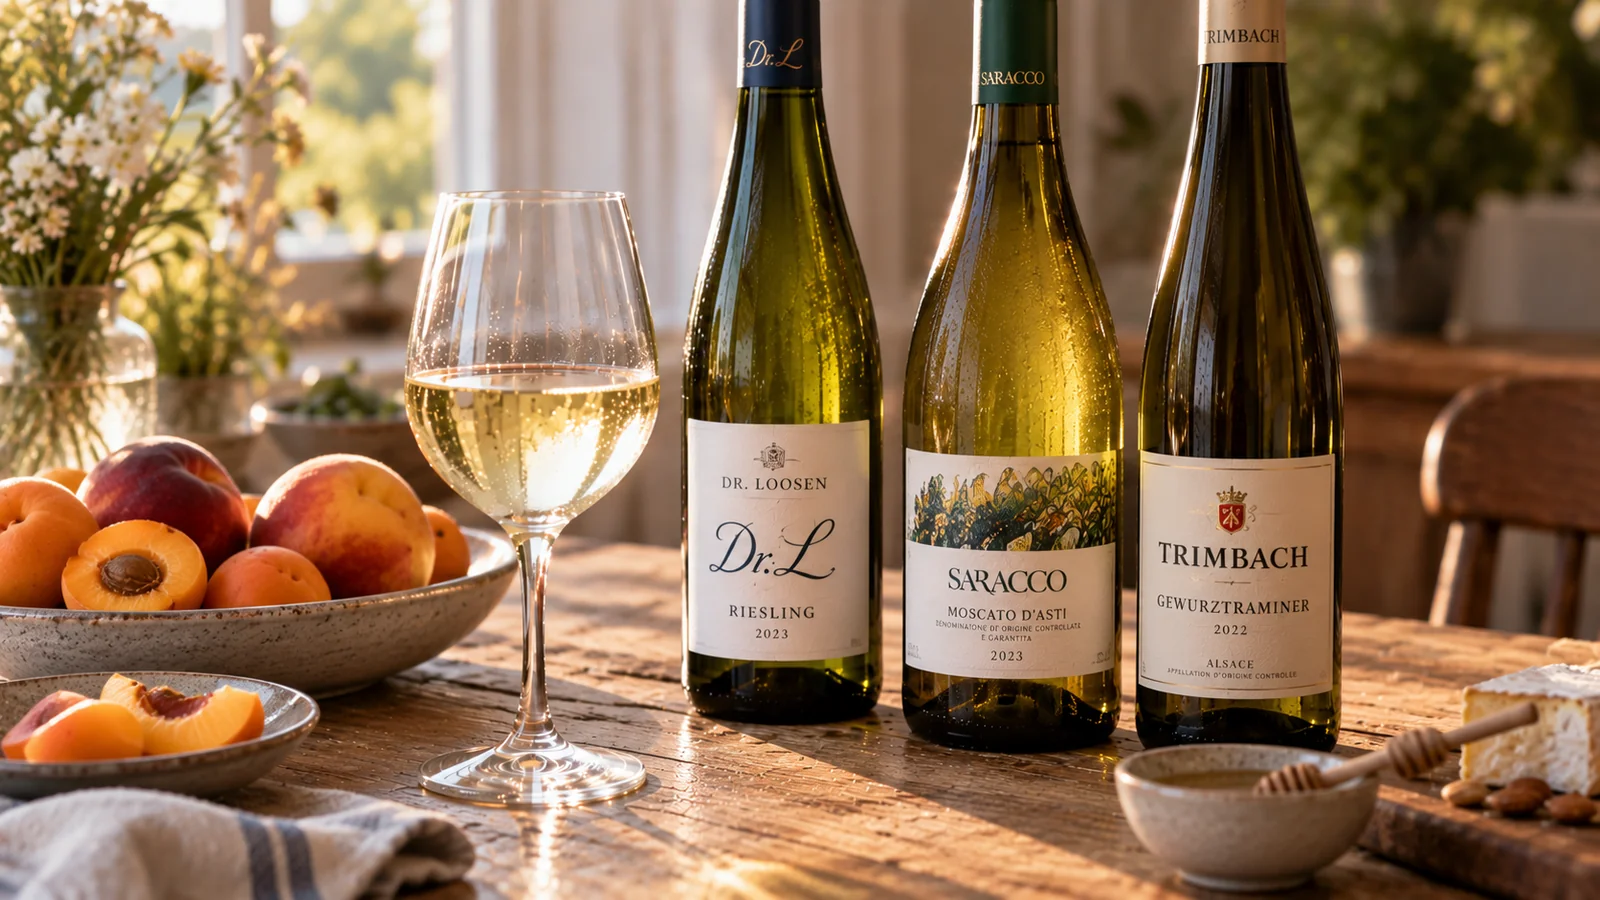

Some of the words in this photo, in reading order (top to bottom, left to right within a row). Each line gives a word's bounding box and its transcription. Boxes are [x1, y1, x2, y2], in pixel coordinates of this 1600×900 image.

[981, 70, 1046, 86] SARACCO
[722, 476, 748, 490] DR.
[755, 477, 828, 491] LOOSEN
[1158, 541, 1308, 570] TRIMBACH
[948, 567, 1068, 596] SARACCO
[729, 604, 815, 619] RIESLING
[1157, 594, 1310, 615] GEWURZTRAMINER
[947, 606, 1017, 621] MOSCATO
[1022, 608, 1067, 621] D'ASTI
[755, 628, 789, 639] 2023
[1001, 624, 1032, 632] ORIGINE
[1214, 624, 1248, 636] 2022
[990, 650, 1023, 662] 2023
[1206, 659, 1254, 669] ALSACE
